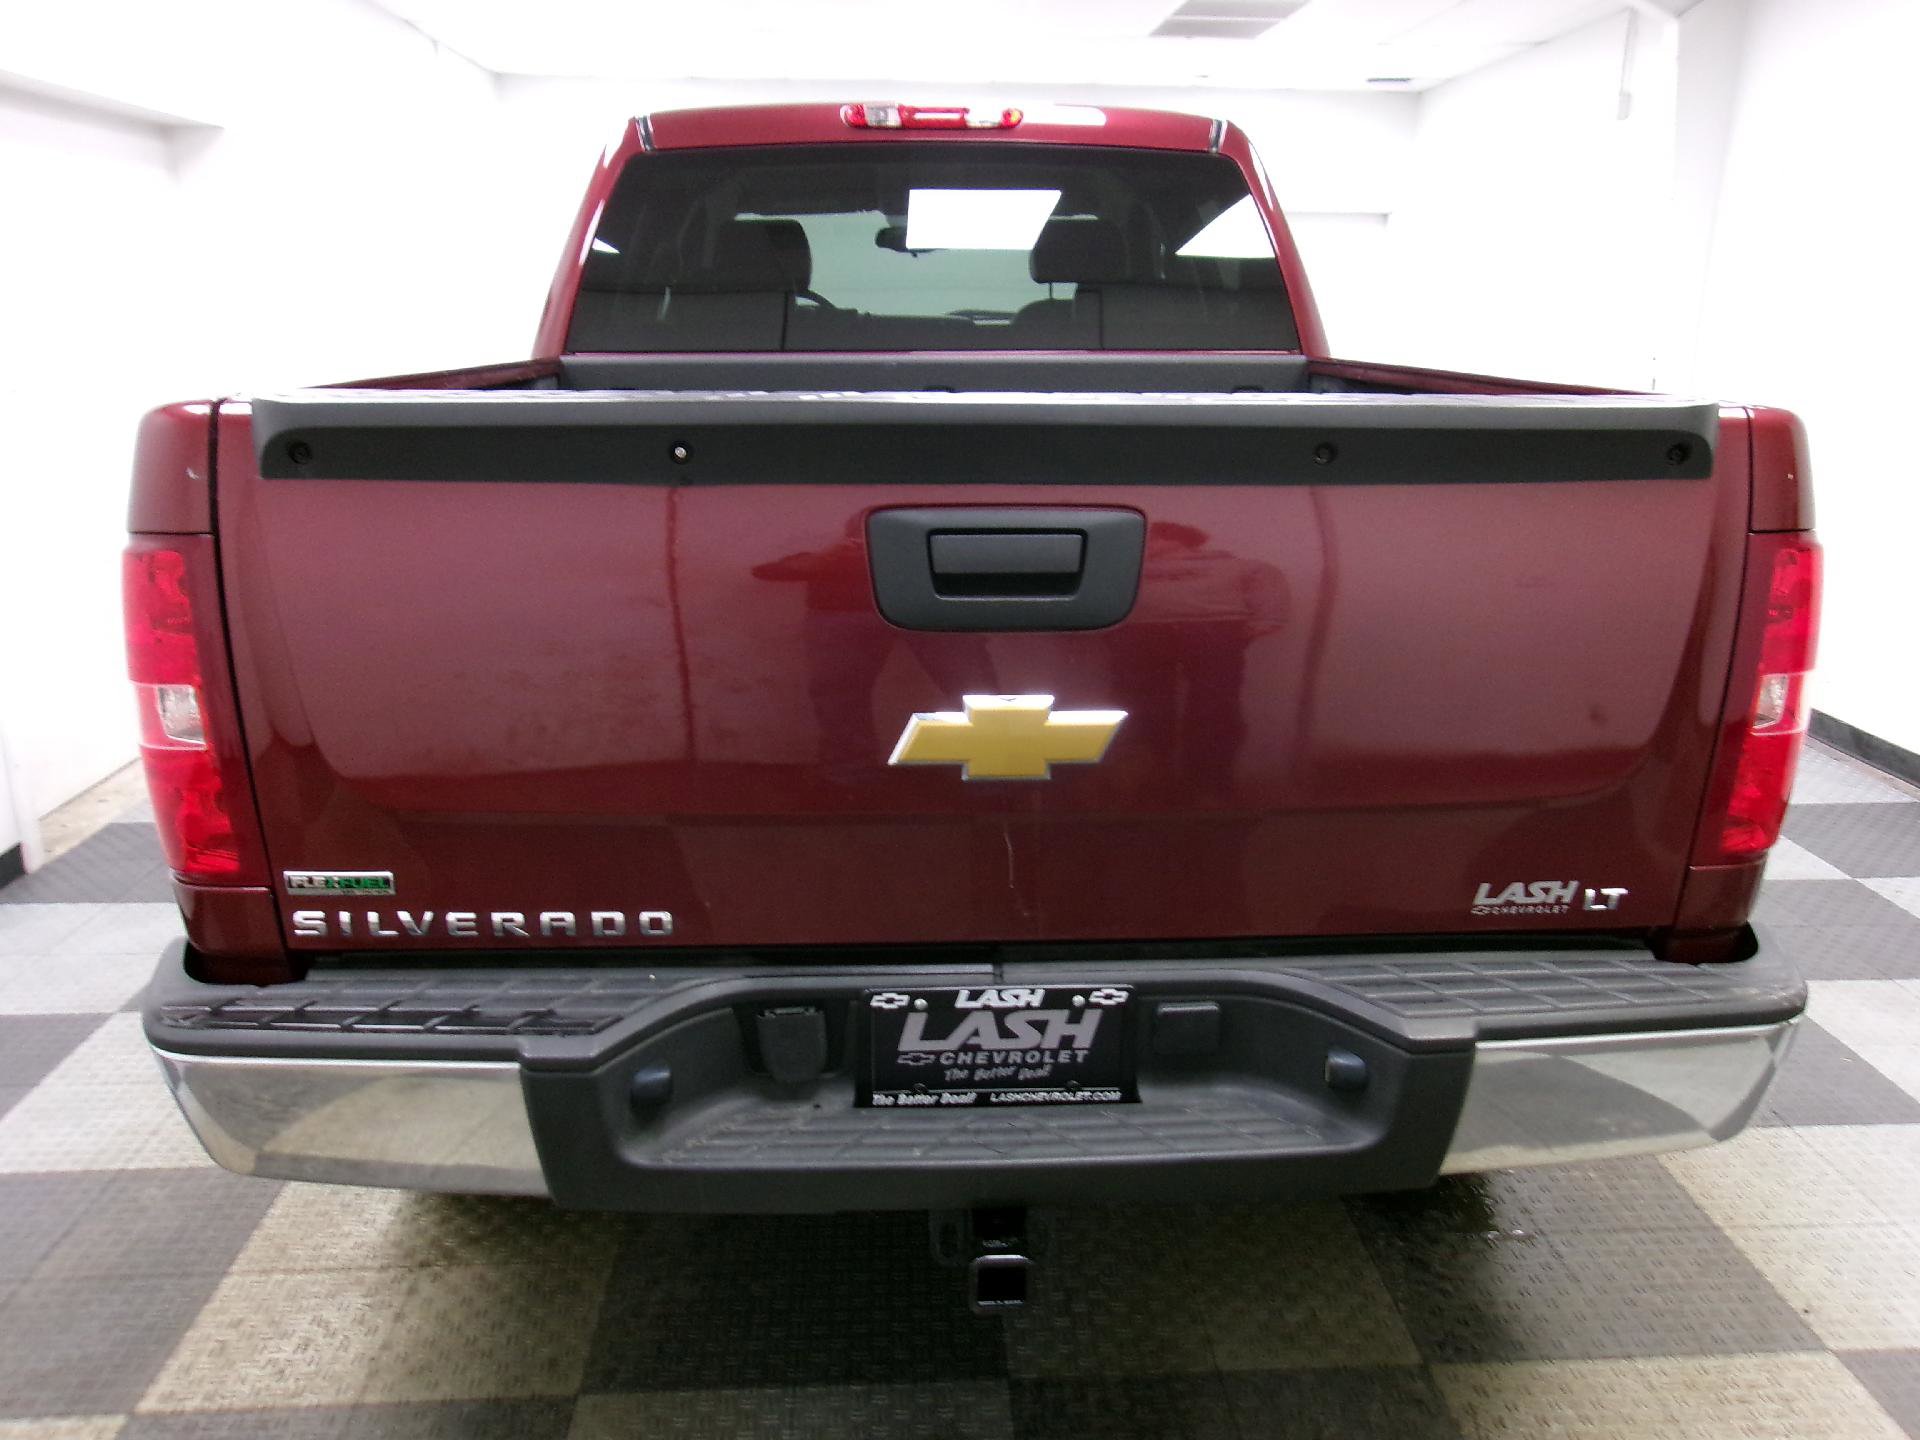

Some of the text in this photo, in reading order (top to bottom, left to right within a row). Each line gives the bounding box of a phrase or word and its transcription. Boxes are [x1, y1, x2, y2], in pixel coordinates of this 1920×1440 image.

[1473, 880, 1580, 905] LASH
[1584, 888, 1628, 910] LT
[292, 910, 674, 938] SILVERADO
[954, 988, 1045, 1008] LASH
[898, 1008, 1103, 1051] LASH
[939, 1050, 1090, 1065] CHEVROLET
[943, 1067, 969, 1081] The
[872, 1093, 895, 1106] The
[897, 1093, 938, 1105] Better
[990, 1091, 1122, 1103] LASHCHEVROLET.COM
